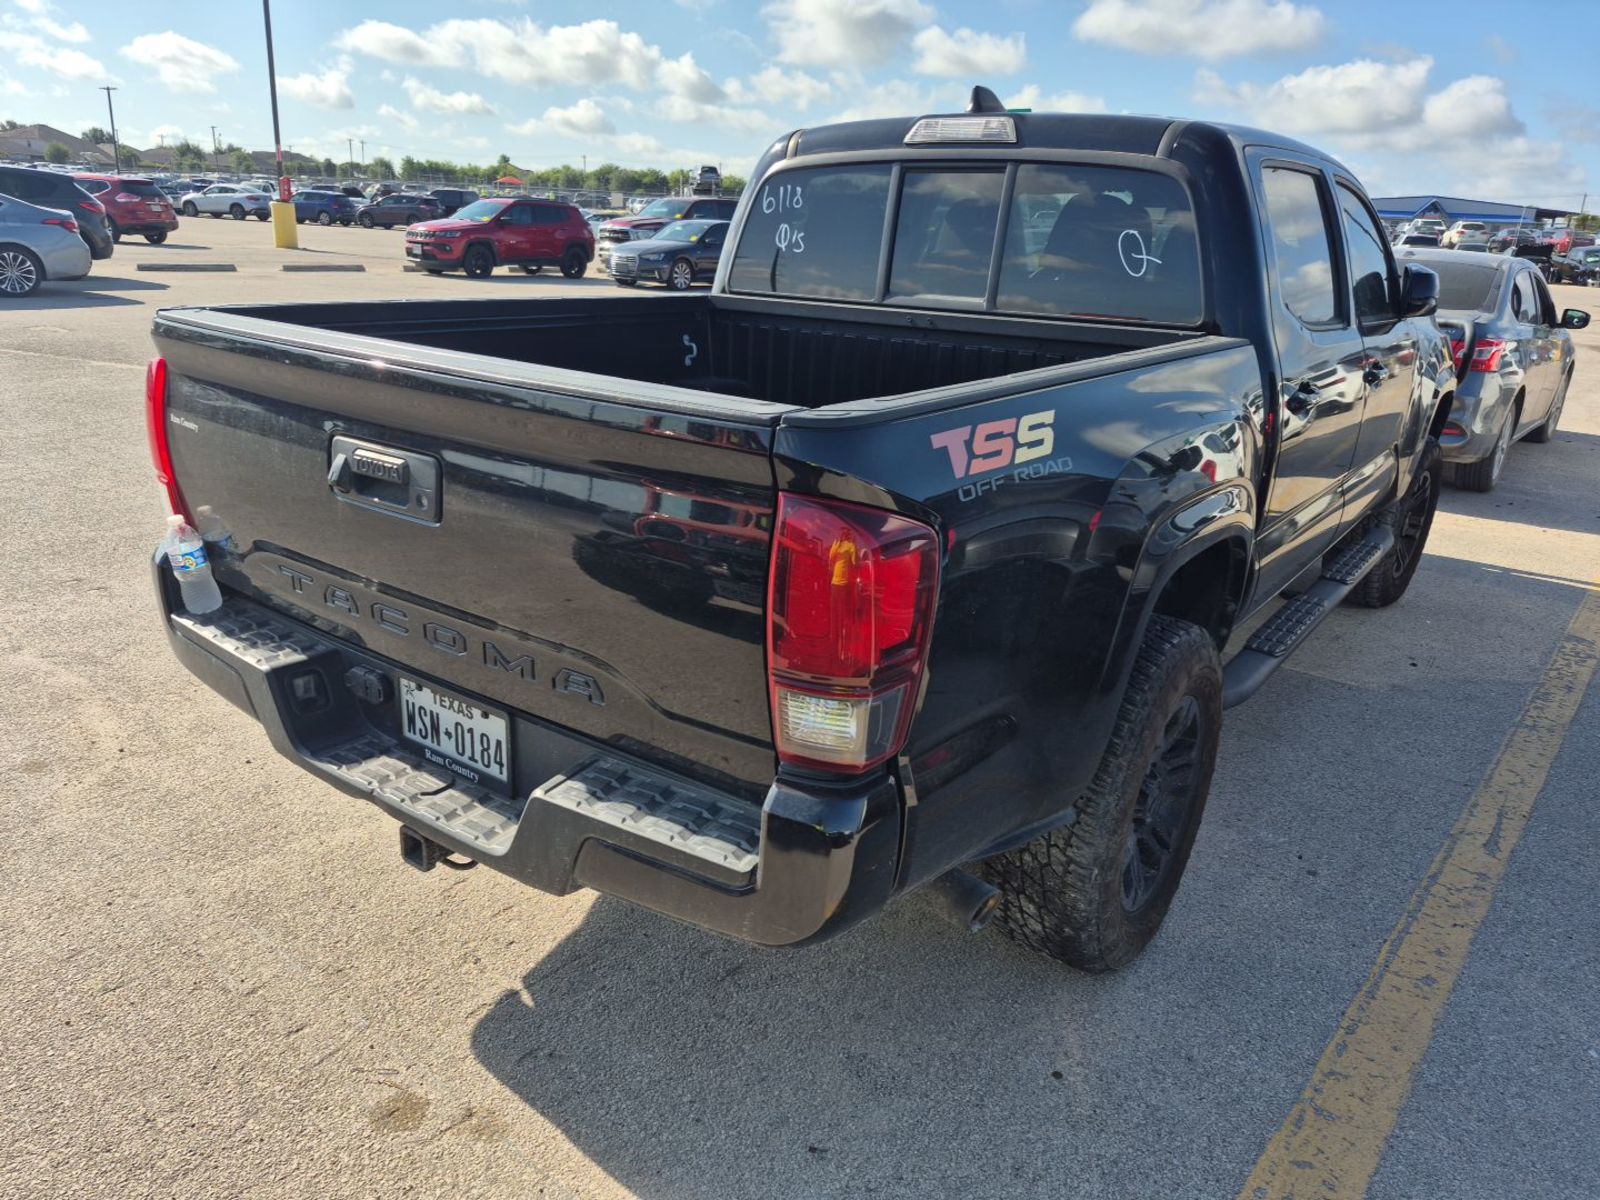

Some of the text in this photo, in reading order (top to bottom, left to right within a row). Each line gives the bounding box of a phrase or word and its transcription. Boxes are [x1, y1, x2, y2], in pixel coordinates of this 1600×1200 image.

[762, 184, 803, 214] 6118
[930, 409, 1056, 479] TSS
[354, 457, 401, 480] TOYOTA
[958, 457, 1073, 502] OFF ROAD
[278, 564, 606, 707] TACOMA
[430, 690, 475, 720] TEXAS
[424, 748, 480, 783] Ram Country
